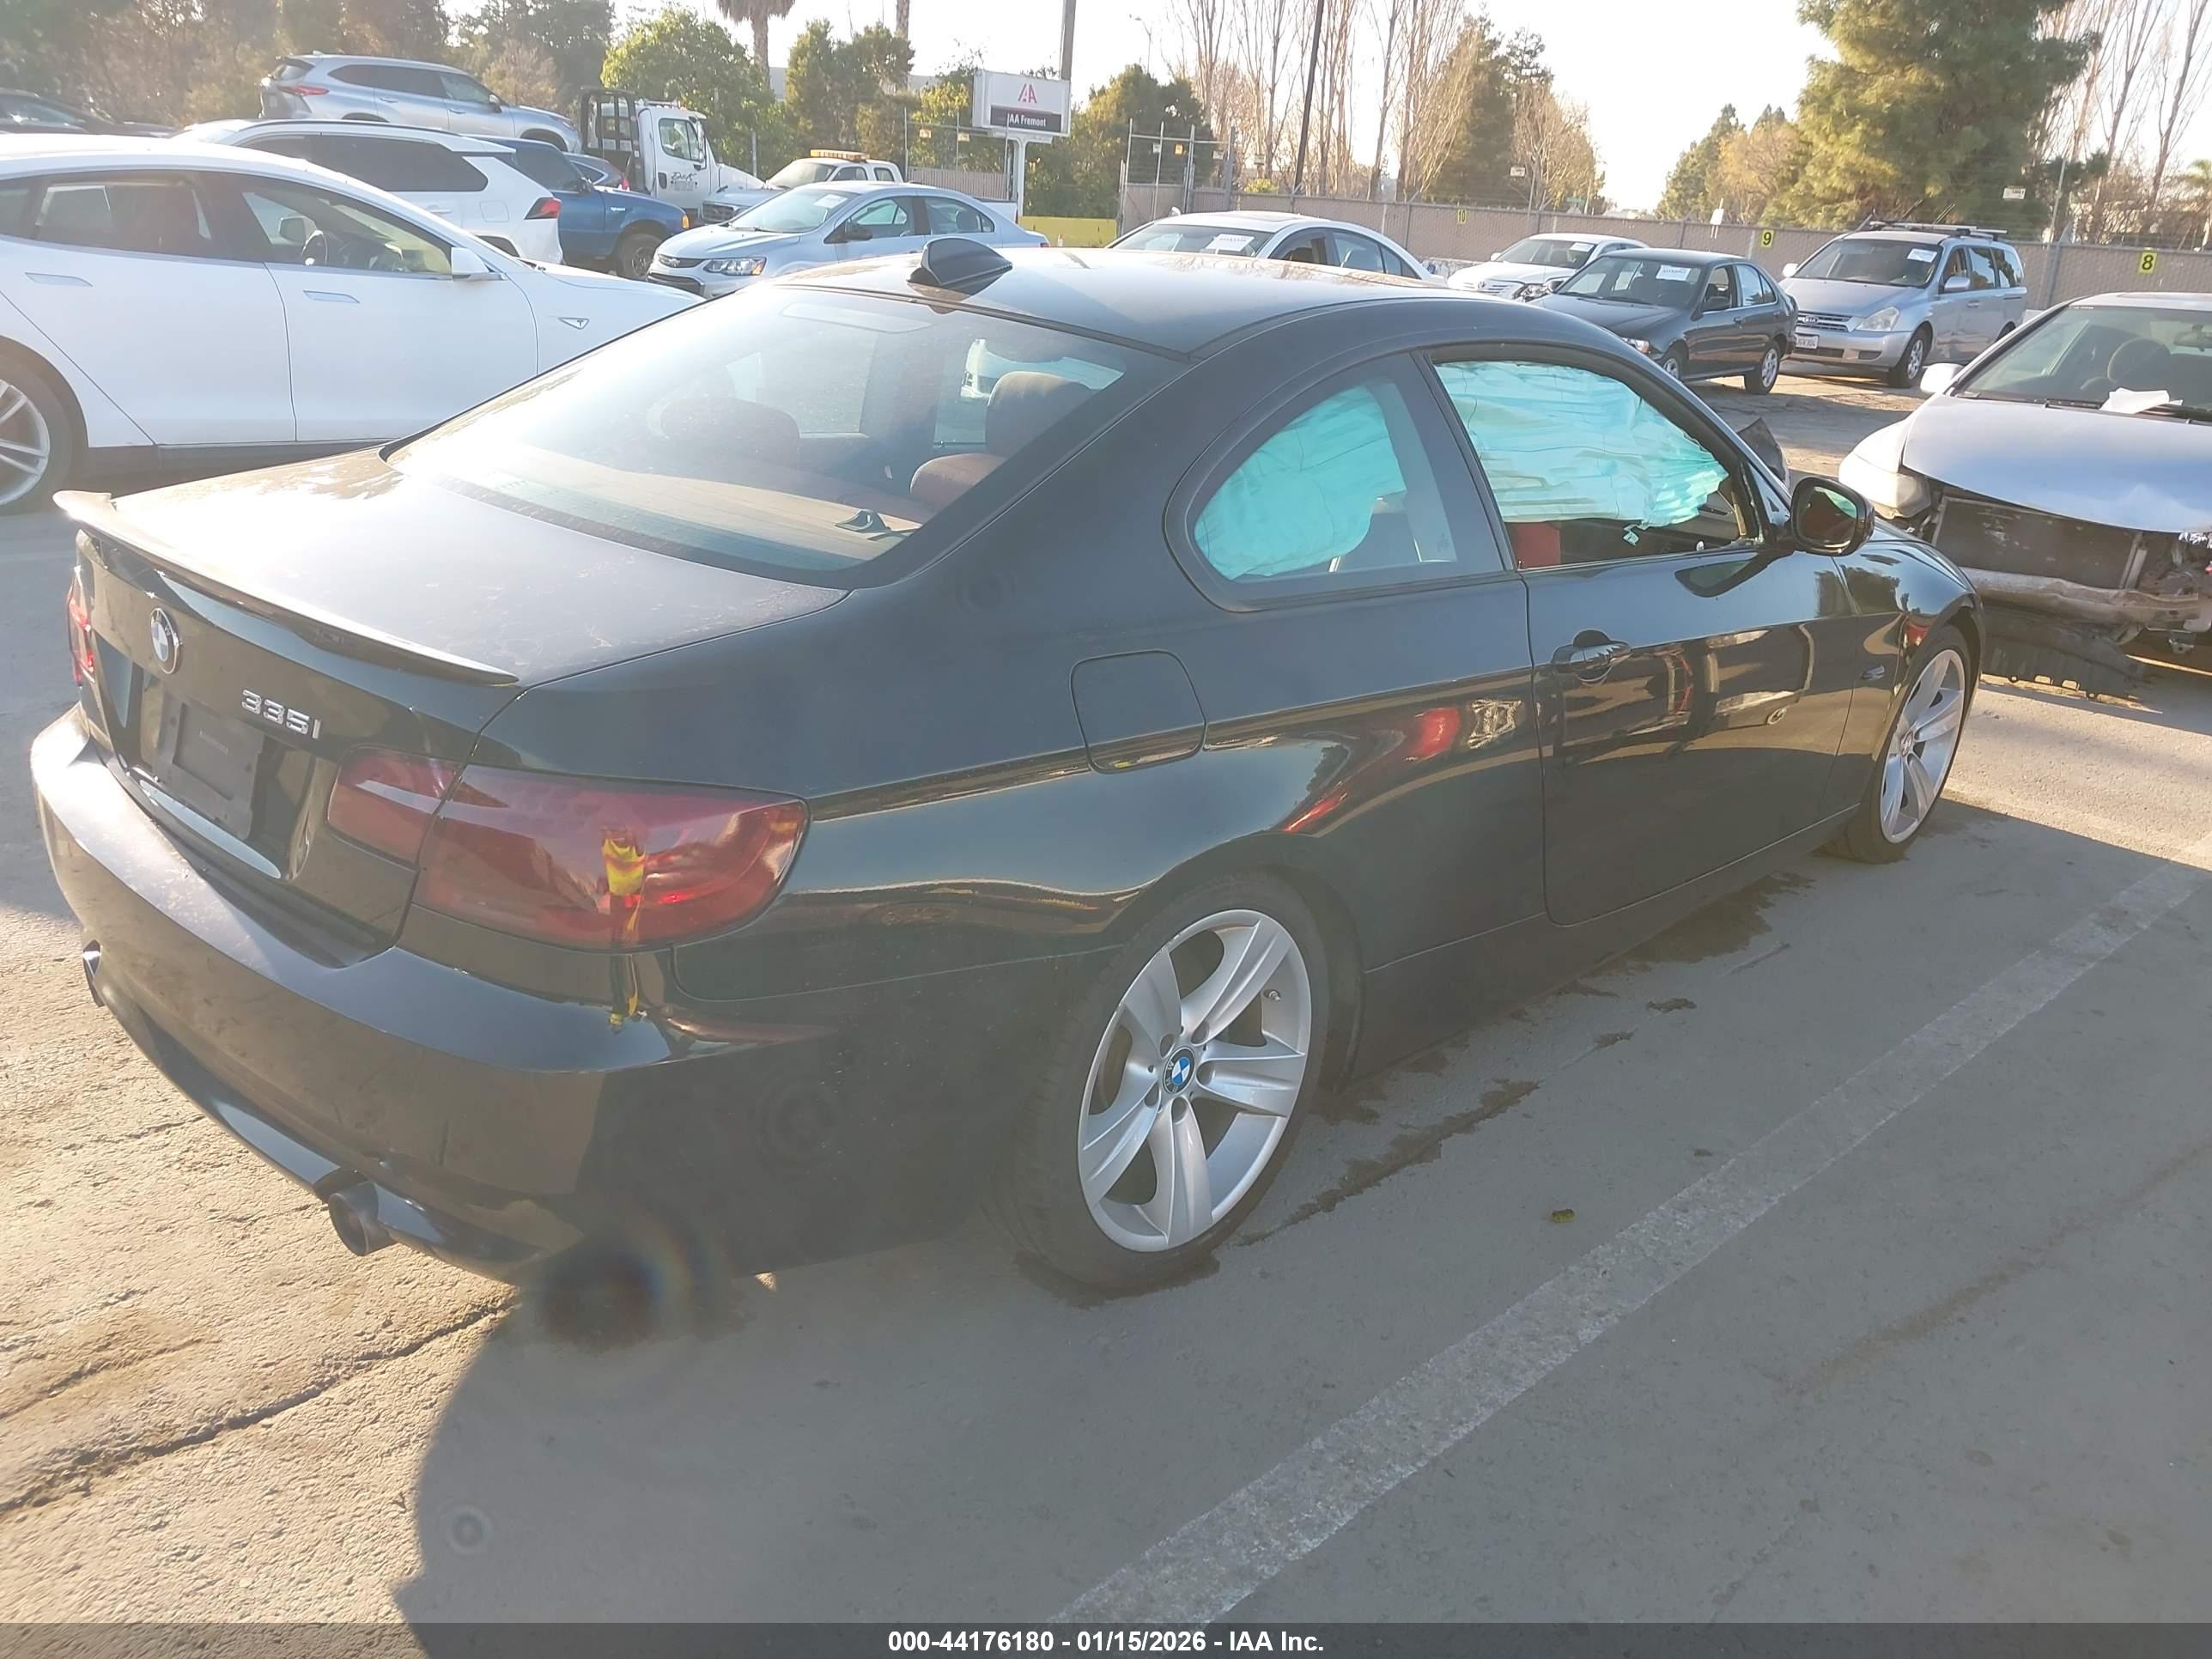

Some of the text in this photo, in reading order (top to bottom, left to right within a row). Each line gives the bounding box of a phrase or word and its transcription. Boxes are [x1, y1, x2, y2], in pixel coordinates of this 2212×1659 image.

[1021, 114, 1046, 127] Fremont
[1458, 210, 1466, 223] 10
[1763, 232, 1771, 246] 9
[2142, 254, 2154, 270] 8
